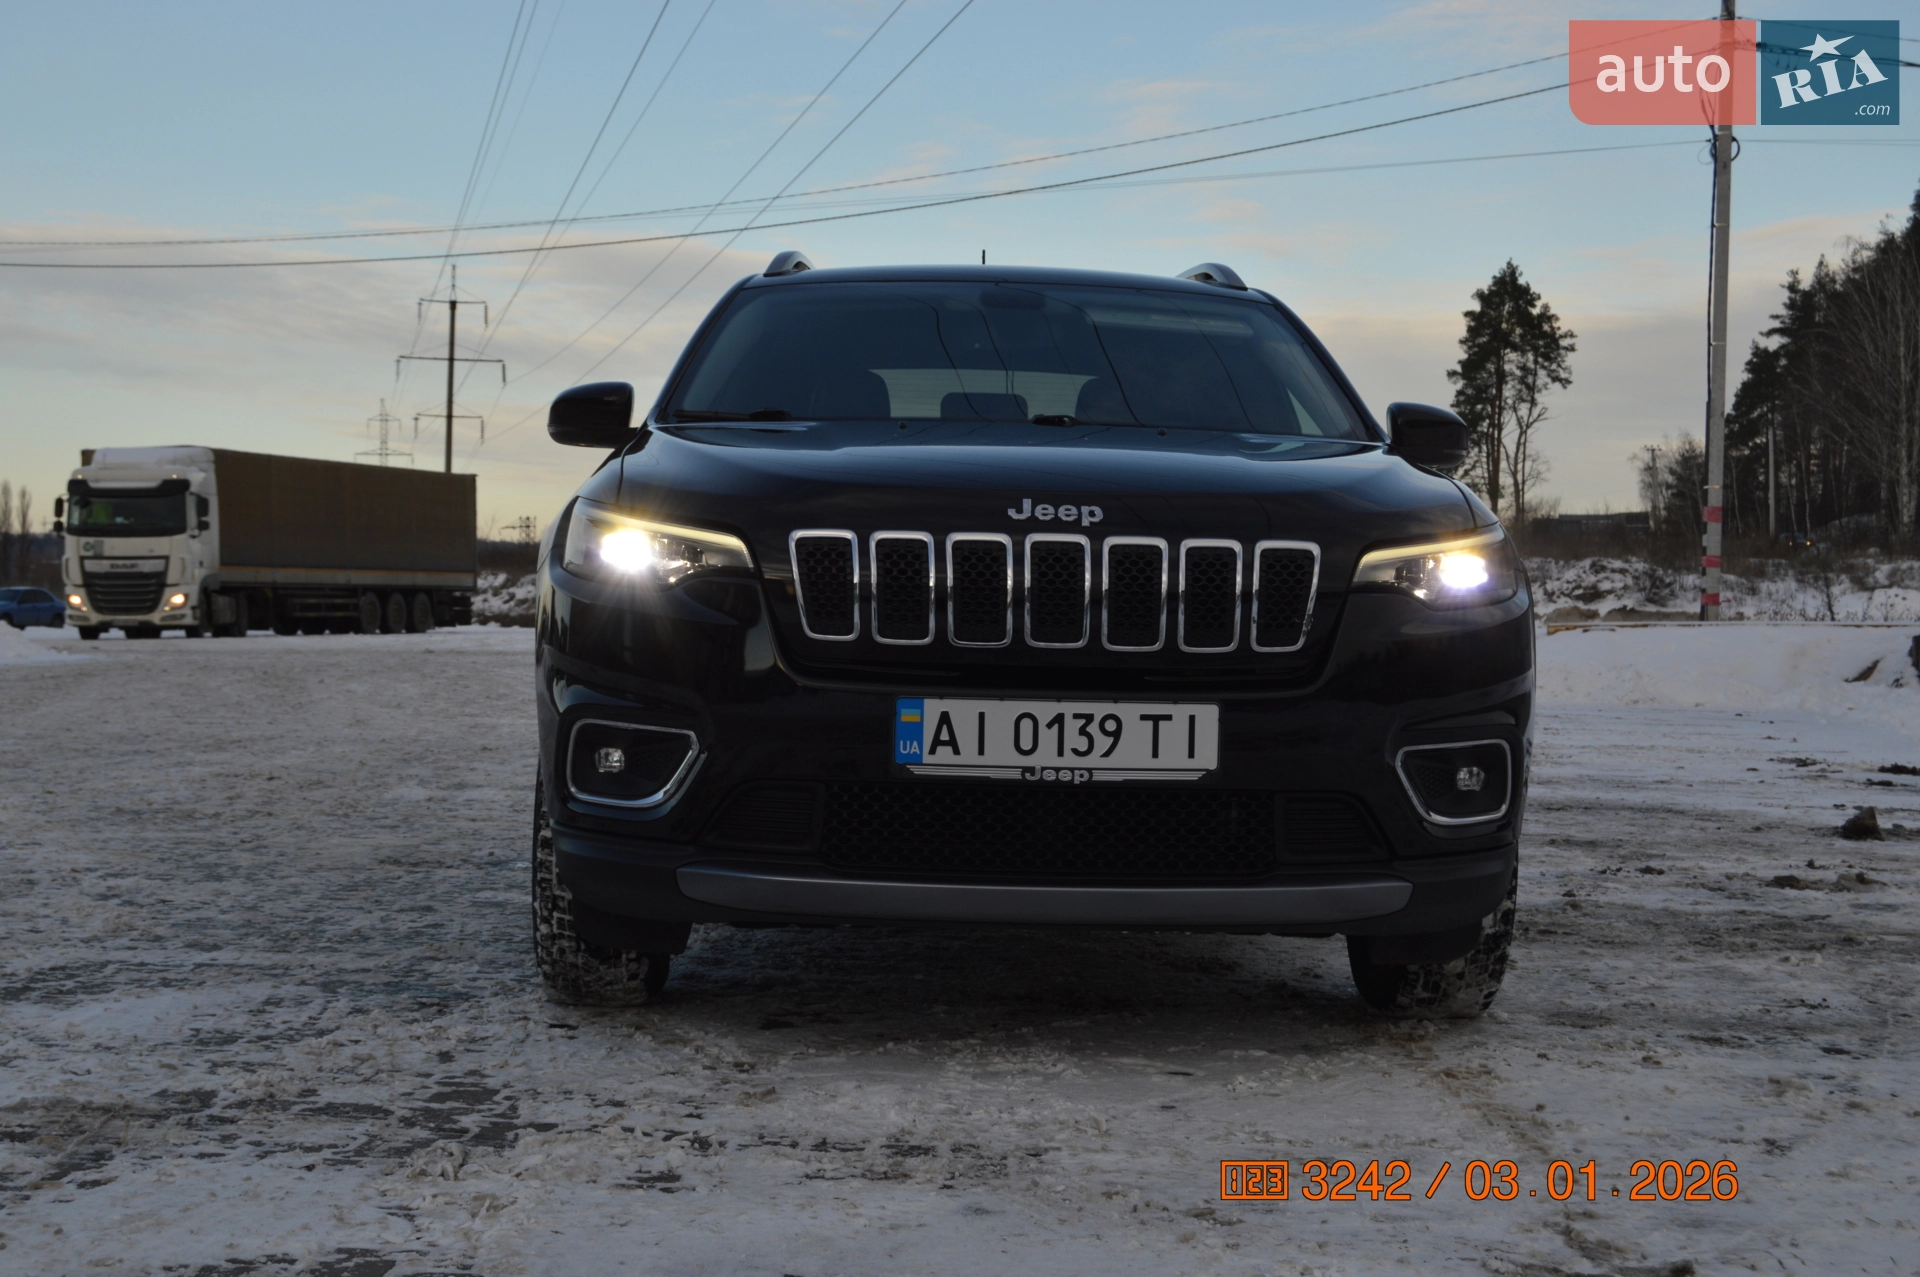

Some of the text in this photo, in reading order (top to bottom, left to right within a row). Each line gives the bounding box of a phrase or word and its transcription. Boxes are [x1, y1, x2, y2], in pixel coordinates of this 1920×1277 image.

[1007, 498, 1104, 527] Jeep
[927, 710, 1196, 759] AI 0139 TI
[900, 740, 920, 755] UA
[1024, 765, 1090, 784] Jeep
